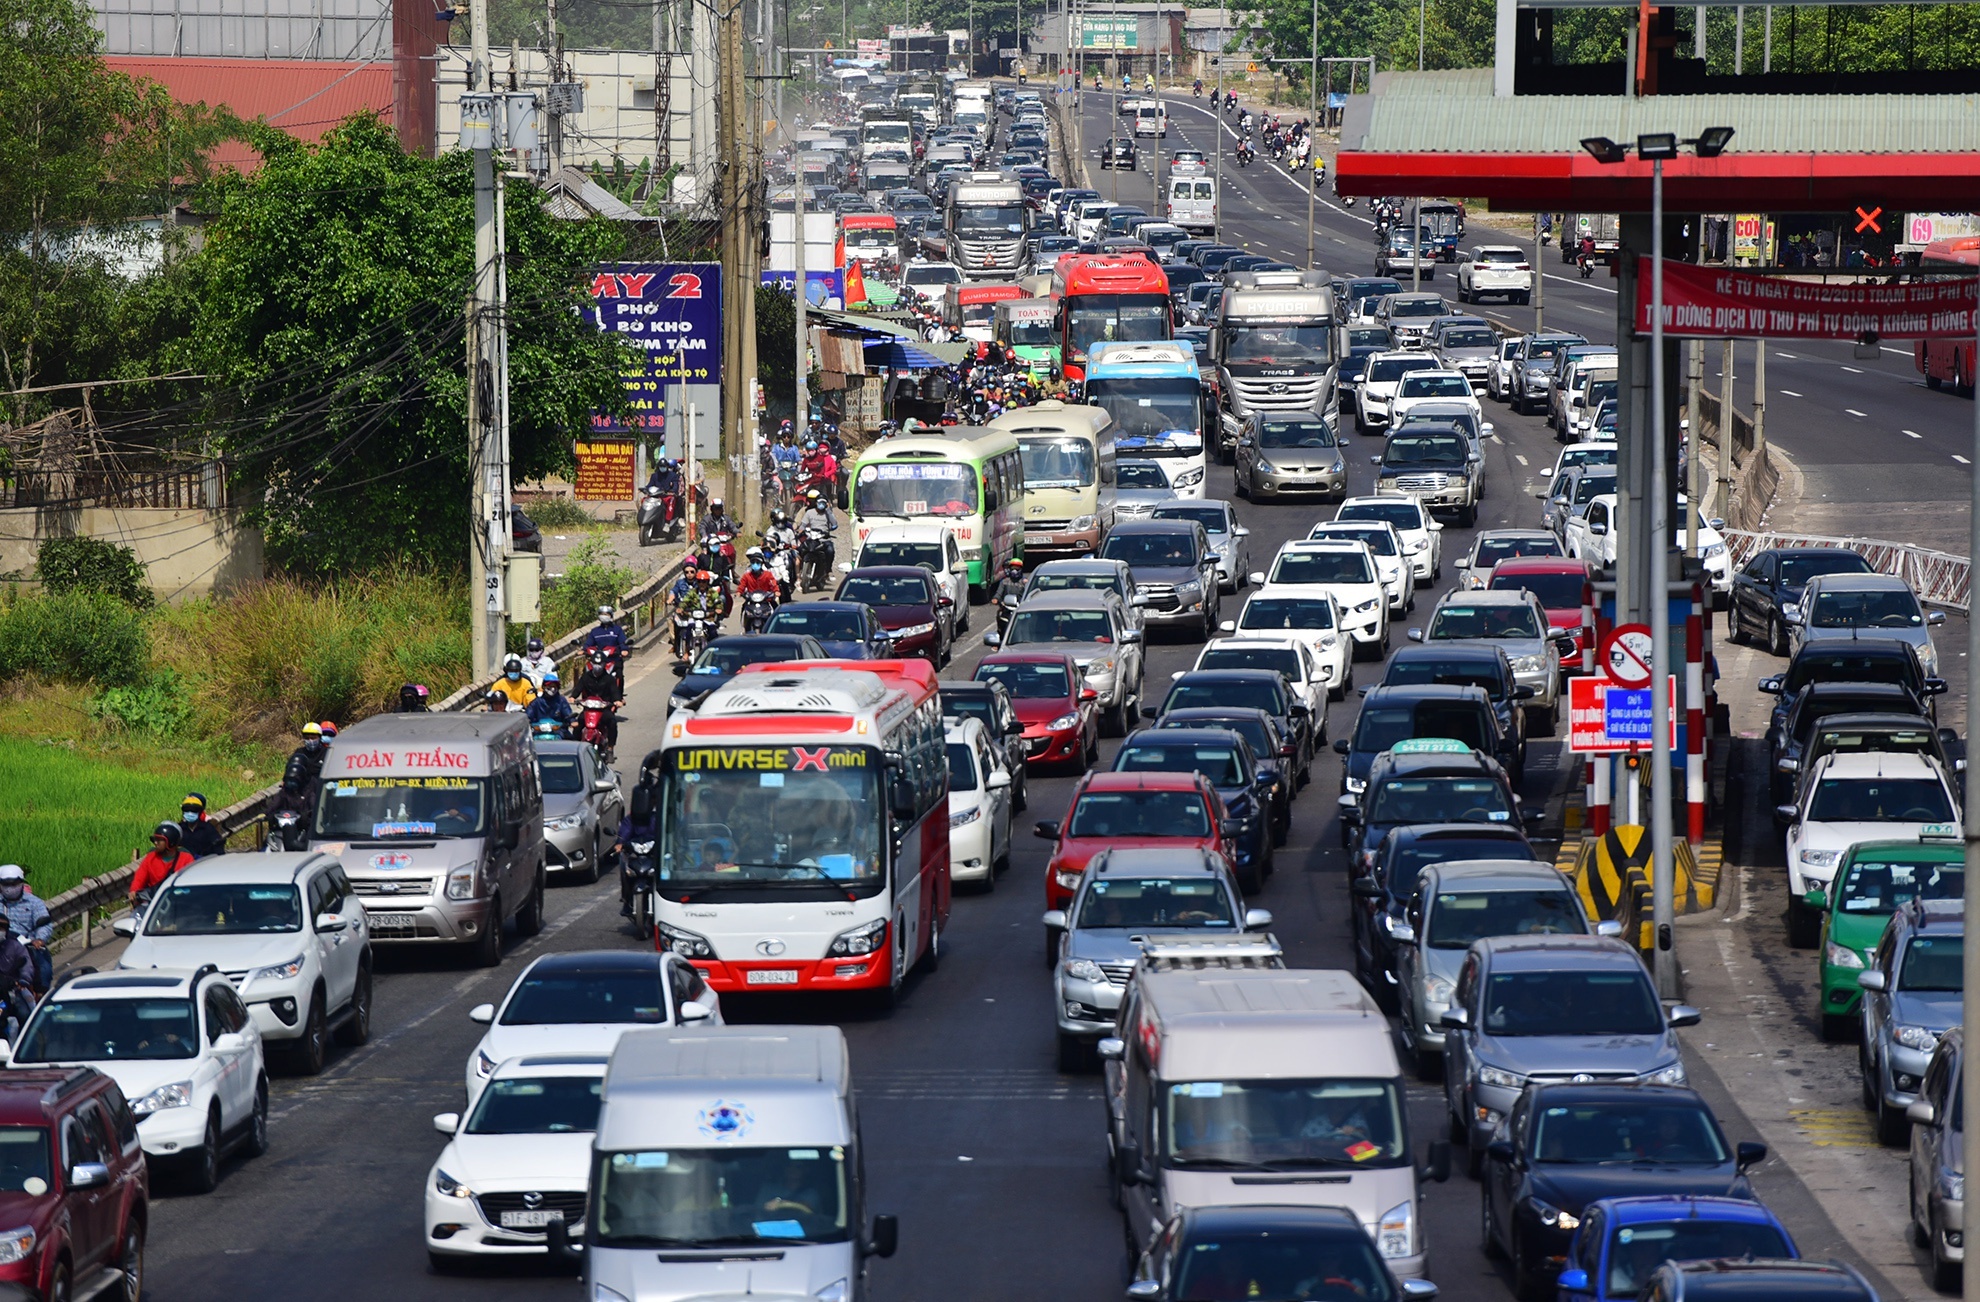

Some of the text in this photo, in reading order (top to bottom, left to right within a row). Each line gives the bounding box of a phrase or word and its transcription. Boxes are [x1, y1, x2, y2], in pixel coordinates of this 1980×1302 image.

[1912, 218, 1932, 242] 69
[666, 273, 702, 298] 2
[1716, 273, 1732, 294] KỂ
[1736, 278, 1751, 295] TỪ
[1755, 282, 1790, 299] NGÀY
[1794, 287, 1865, 302] 01/12/2018
[1869, 288, 1905, 306] TRẠM
[1910, 287, 1934, 300] THU
[1939, 285, 1960, 299] PHÍ
[963, 292, 989, 301] KUMHO
[617, 302, 659, 314] PHỞ
[1247, 303, 1308, 313] HYUNDAI
[617, 319, 693, 332] BÒ KHO
[1645, 302, 1968, 337] TM DỪNG DỊCH VỤ THU PHÍ TỰ ĐỘNG KHÔNG DỪNG
[667, 336, 706, 349] TẤM
[654, 355, 676, 366] HỘP
[694, 368, 708, 379] TỘ
[643, 381, 657, 392] TỘ
[606, 441, 620, 454] NHÀ
[906, 503, 925, 512] 611
[957, 528, 972, 540] TÀU
[345, 747, 469, 769] TOÀN THẮNG
[678, 747, 866, 772] UNIVRSE X mini
[378, 777, 396, 788] TÀU
[424, 776, 449, 788] MIỀN
[1922, 825, 1953, 833] TAXI
